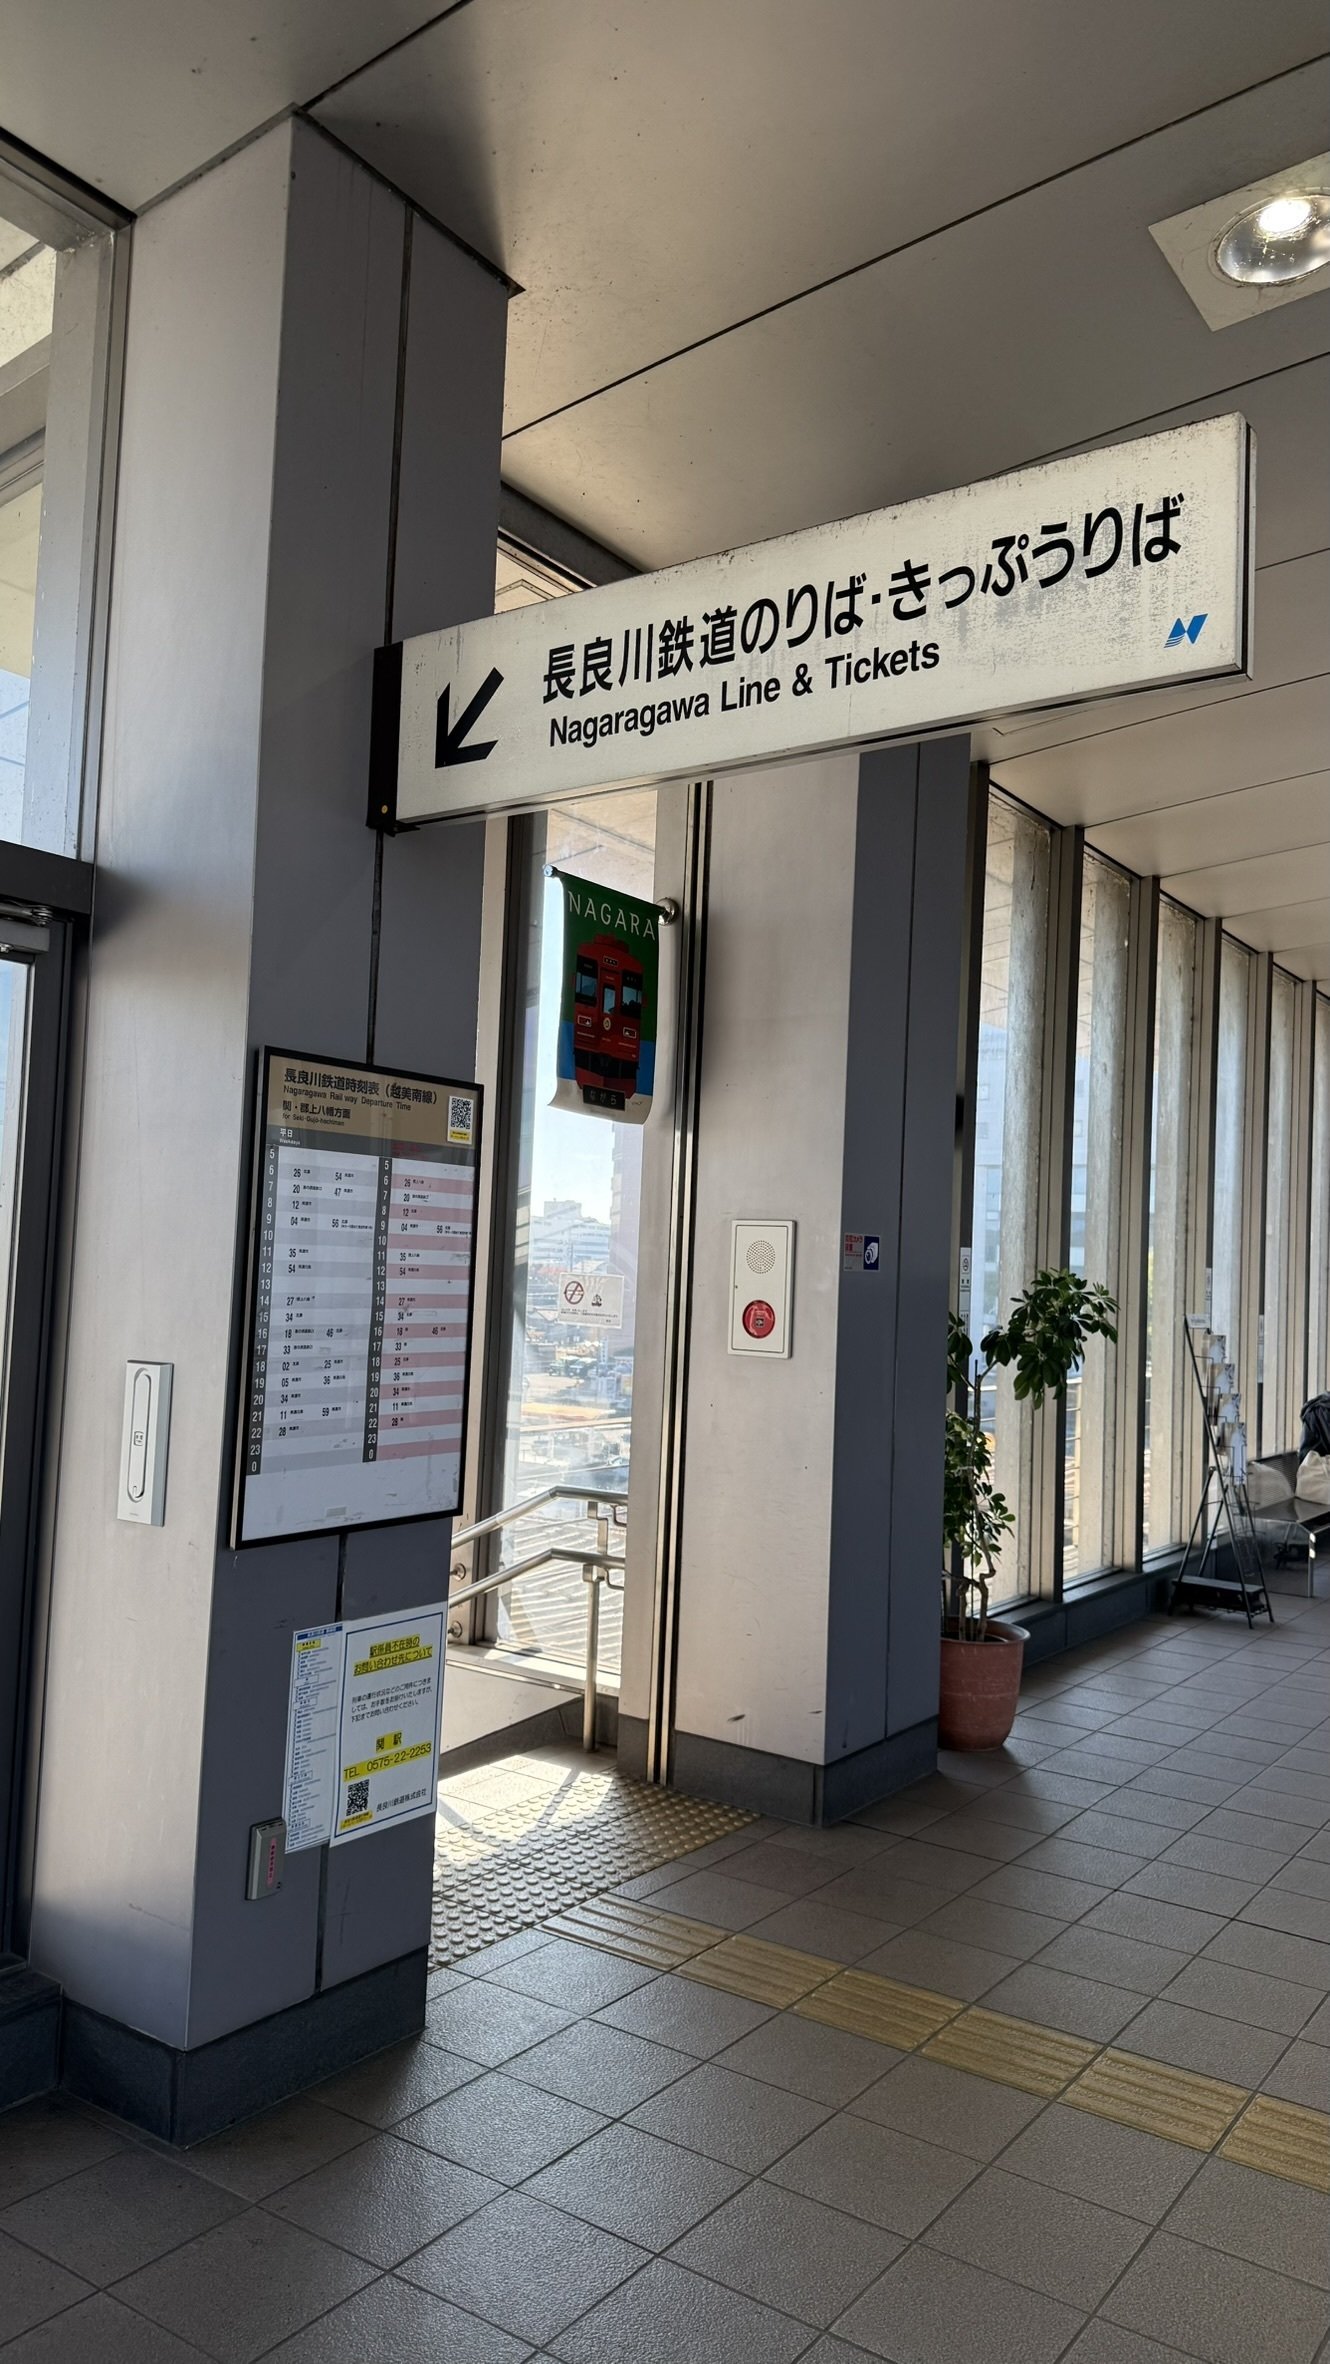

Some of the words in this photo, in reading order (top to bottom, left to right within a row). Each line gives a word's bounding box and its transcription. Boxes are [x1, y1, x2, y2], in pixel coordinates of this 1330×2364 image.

[549, 693, 710, 747] Nagaragawa
[721, 677, 781, 712] Line
[792, 664, 812, 696] &
[825, 640, 940, 689] Tickets
[567, 890, 656, 941] NAGARA
[283, 1086, 327, 1099] Nagaragawa
[361, 1096, 393, 1108] Departure
[397, 1102, 411, 1111] Time
[280, 1128, 293, 1138] 平日
[269, 1149, 275, 1159] 5
[384, 1160, 389, 1171] 5
[269, 1165, 274, 1175] 6
[335, 1172, 342, 1181] 54
[383, 1176, 388, 1186] 6
[268, 1181, 274, 1191] 7
[292, 1184, 300, 1194] 20
[334, 1188, 342, 1197] 47
[383, 1191, 388, 1200] 7
[403, 1193, 410, 1202] 20
[267, 1197, 273, 1208] 8
[292, 1200, 300, 1210] 12
[381, 1205, 387, 1216] 8
[403, 1208, 409, 1217] 12
[266, 1213, 272, 1224] 9
[381, 1221, 385, 1231] 9
[263, 1230, 273, 1240] 10
[378, 1236, 387, 1246] 10
[262, 1246, 272, 1257] 11
[288, 1248, 296, 1258] 35
[377, 1251, 385, 1260] 11
[262, 1263, 272, 1273] 12
[288, 1264, 296, 1273] 54
[377, 1266, 386, 1276] 12
[399, 1267, 406, 1276] 54
[260, 1279, 271, 1290] 13
[376, 1281, 385, 1291] 13
[260, 1295, 270, 1306] 14
[286, 1297, 294, 1306] 27
[376, 1296, 384, 1306] 14
[398, 1297, 406, 1306] 27
[259, 1312, 269, 1322] 15
[285, 1312, 293, 1322] 34
[375, 1311, 384, 1321] 15
[258, 1328, 268, 1339] 16
[285, 1329, 292, 1339] 18
[374, 1327, 383, 1336] 16
[256, 1344, 267, 1355] 17
[283, 1345, 291, 1355] 33
[373, 1342, 381, 1351] 17
[395, 1342, 402, 1351] 33
[256, 1361, 266, 1372] 18
[282, 1361, 290, 1371] 02
[324, 1360, 331, 1369] 25
[372, 1357, 380, 1367] 18
[370, 1372, 379, 1382] 19
[255, 1378, 265, 1388] 19
[281, 1378, 289, 1388] 05
[369, 1387, 379, 1398] 20
[392, 1387, 399, 1396] 34
[253, 1394, 264, 1405] 20
[280, 1394, 289, 1404] 34
[368, 1403, 377, 1413] 21
[392, 1403, 399, 1411] 11
[252, 1411, 262, 1422] 21
[280, 1411, 287, 1420] 11
[321, 1407, 329, 1417] 59
[368, 1418, 377, 1429] 22
[251, 1428, 261, 1439] 22
[367, 1433, 377, 1444] 23
[250, 1445, 261, 1455] 23
[368, 1449, 374, 1459] 0
[251, 1461, 257, 1472] 0
[393, 1732, 402, 1745] 駅
[344, 1766, 360, 1779] TEL
[366, 1743, 432, 1771] 0575-22-2253
